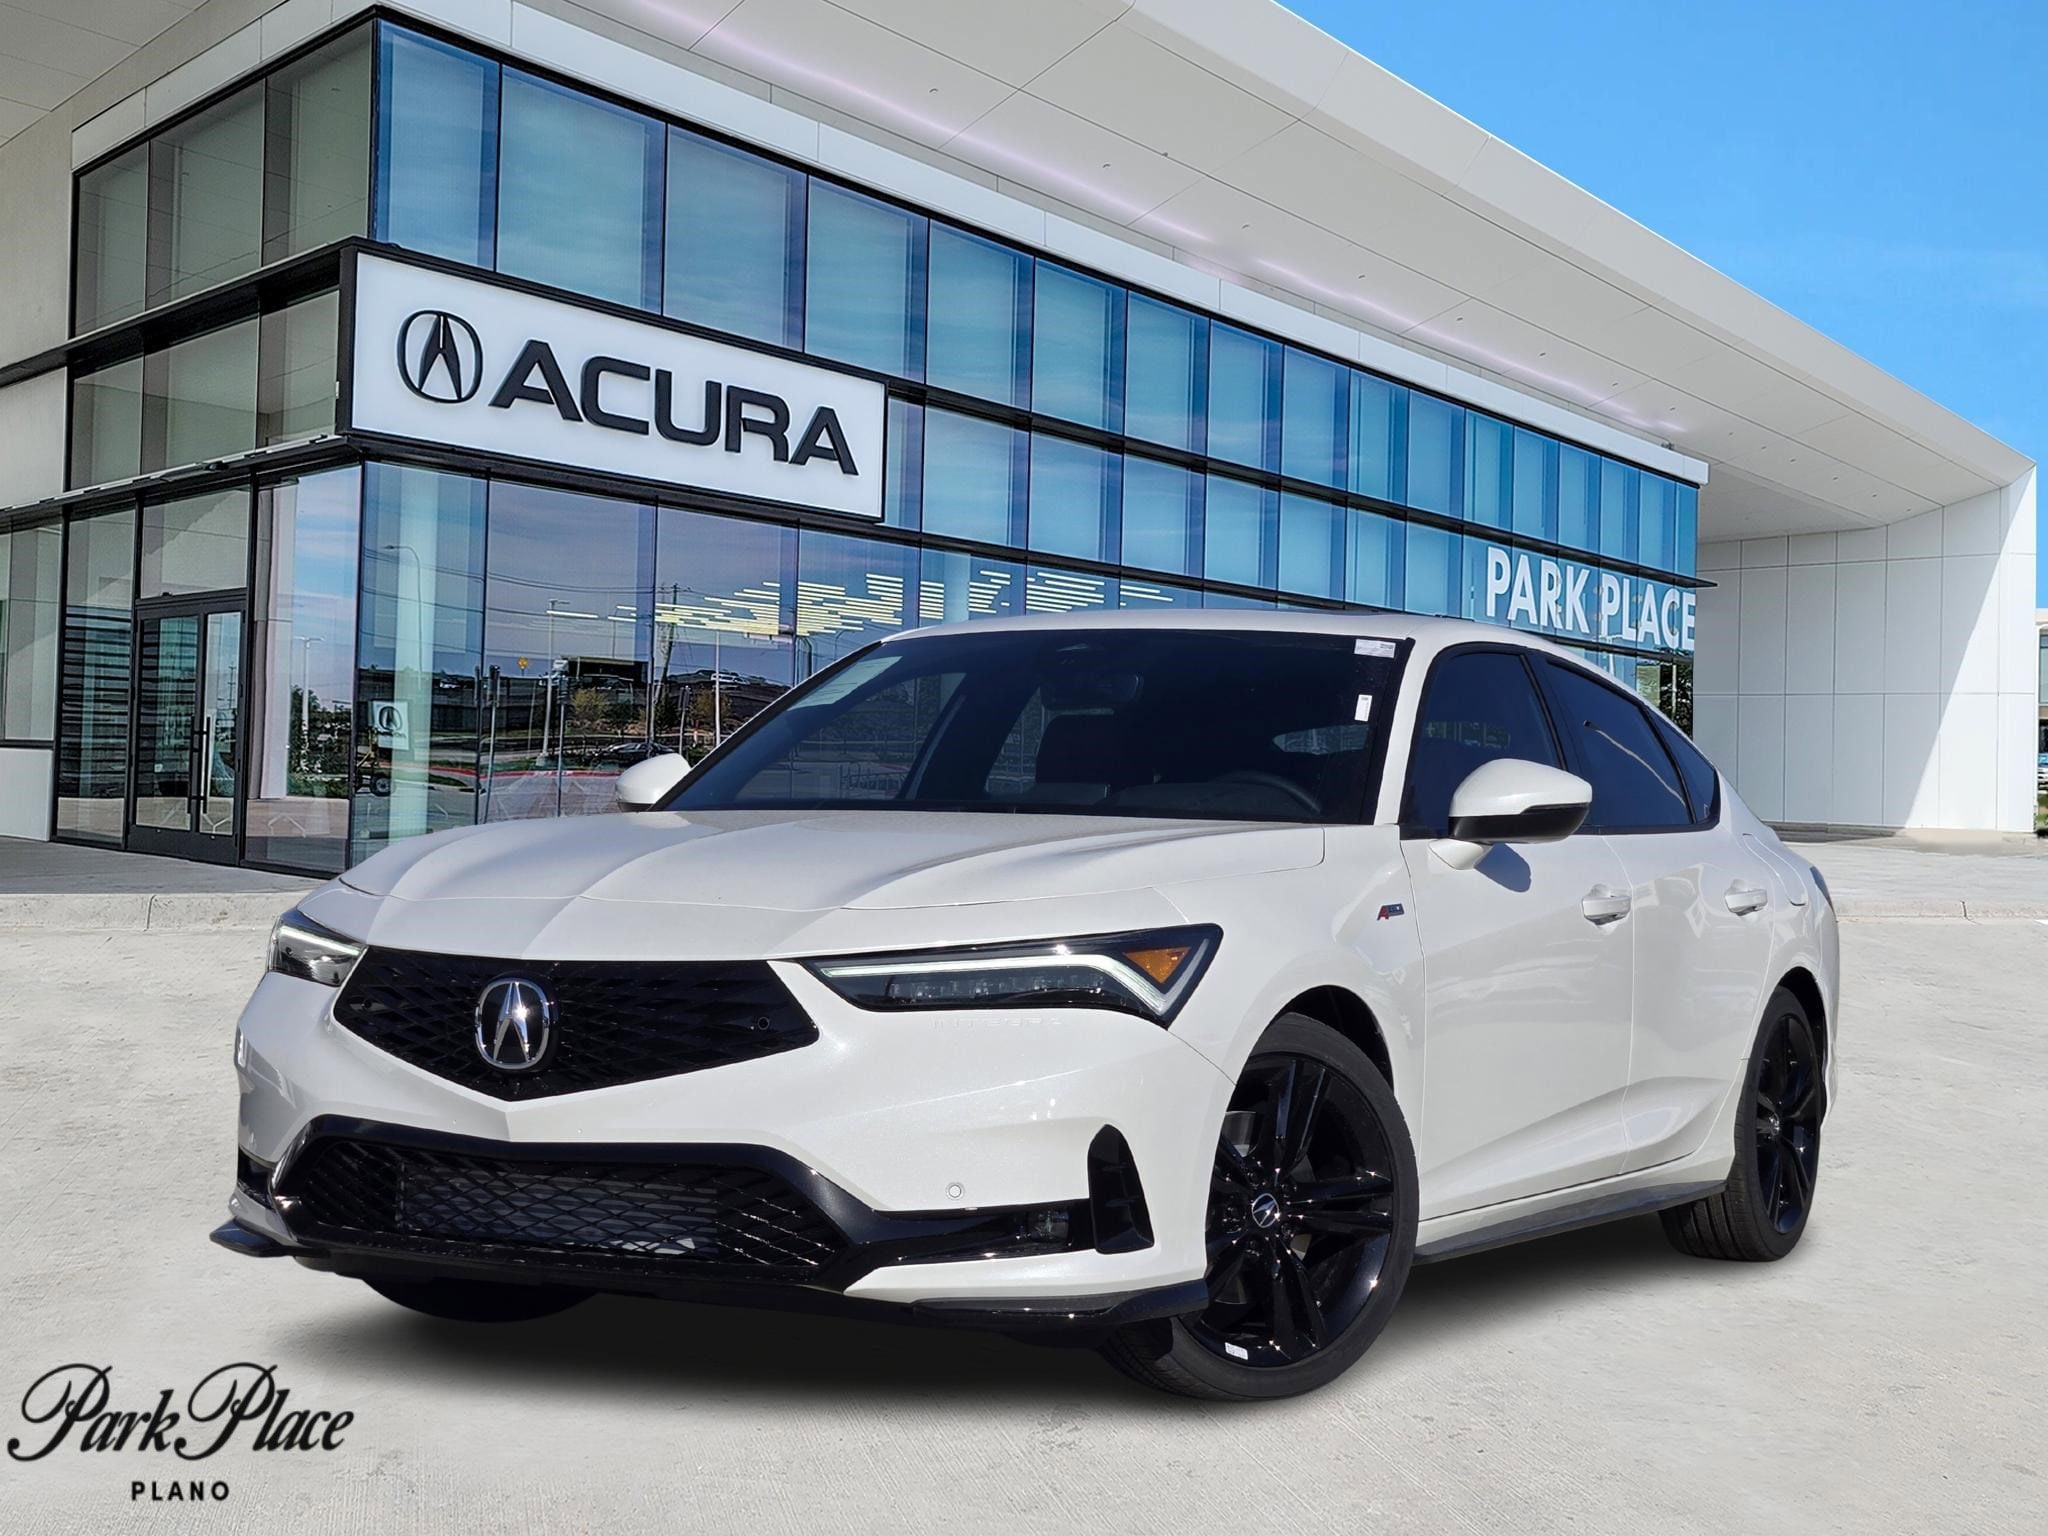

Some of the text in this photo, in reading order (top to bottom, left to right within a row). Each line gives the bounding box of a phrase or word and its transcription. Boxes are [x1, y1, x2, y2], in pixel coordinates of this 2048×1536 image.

[488, 339, 860, 477] ACURA
[1486, 546, 1696, 650] PARK PLACE
